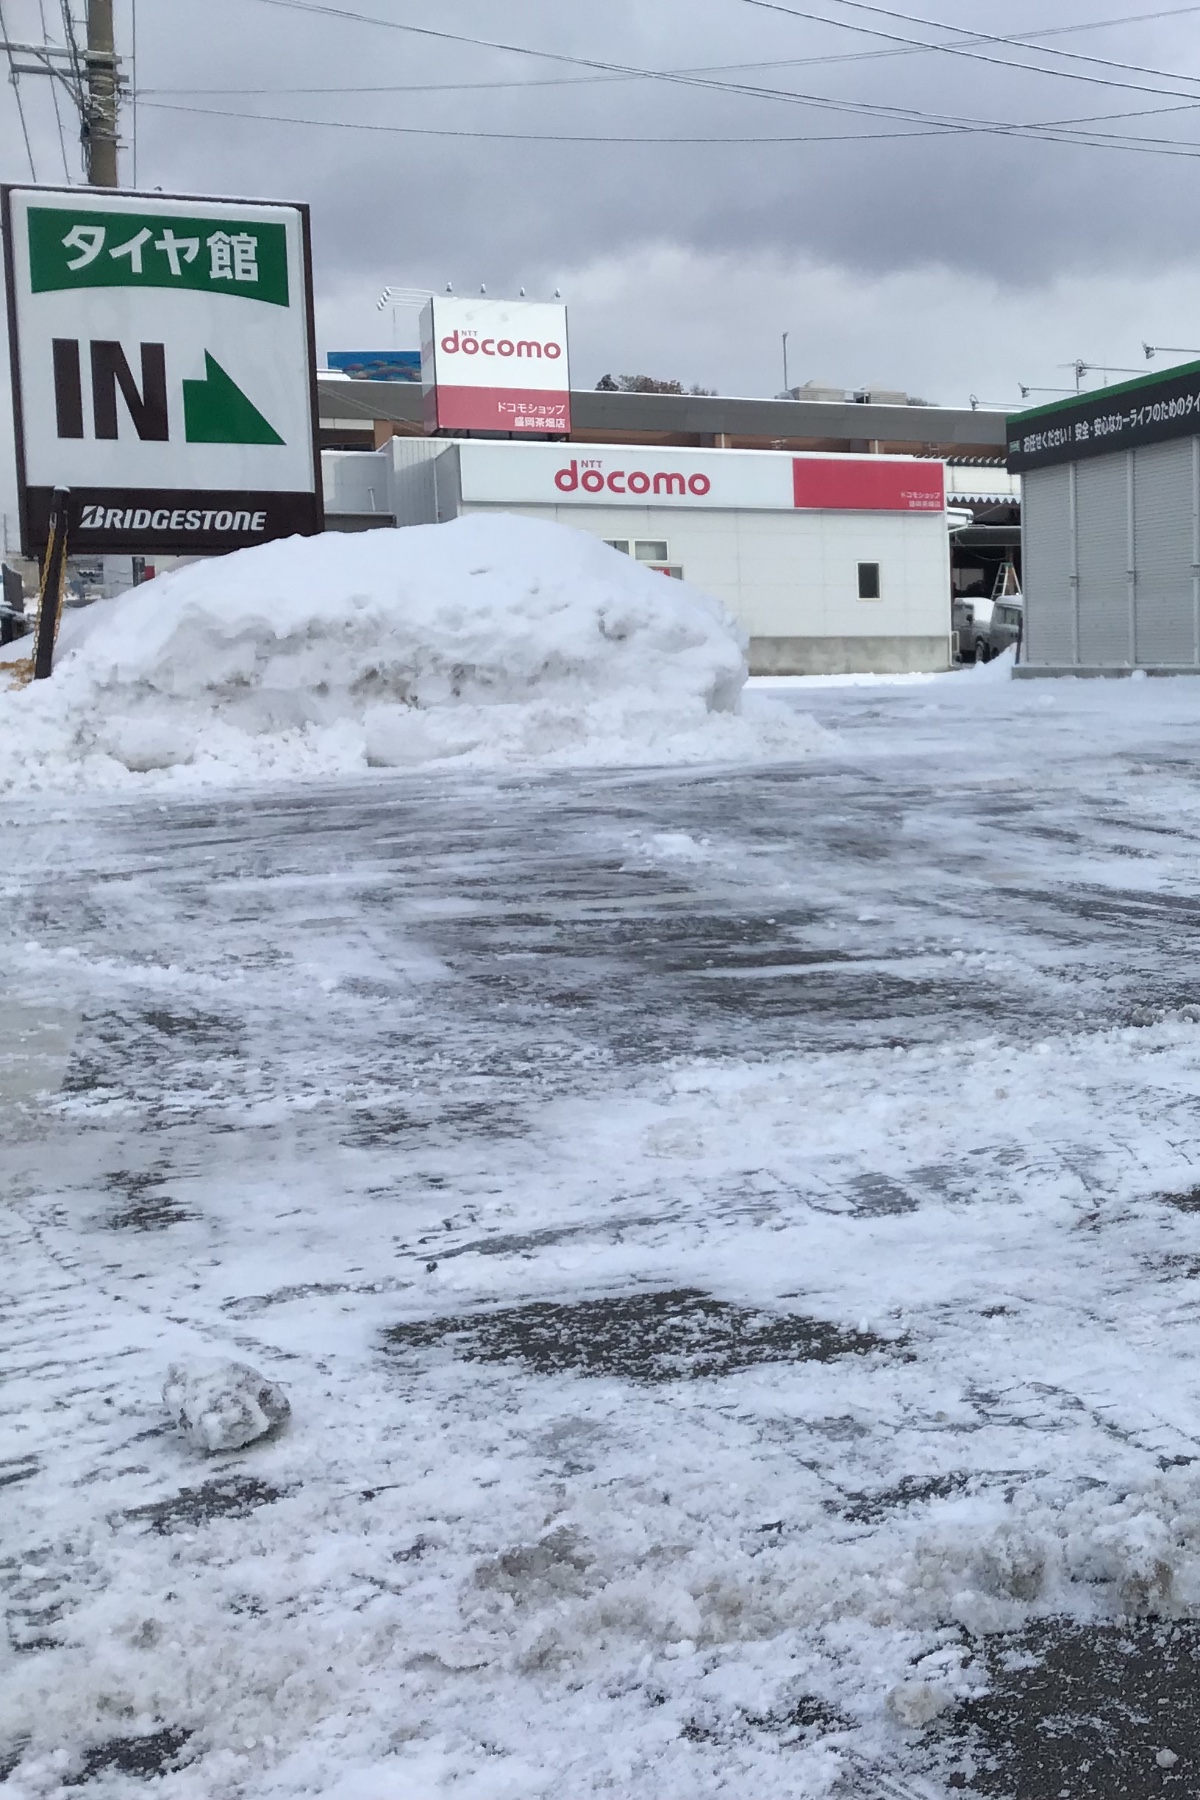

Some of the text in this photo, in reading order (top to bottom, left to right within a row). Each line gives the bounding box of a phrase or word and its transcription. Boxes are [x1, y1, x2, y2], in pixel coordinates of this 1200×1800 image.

[61, 224, 259, 282] タイヤ館
[441, 330, 562, 360] docomo
[52, 338, 169, 442] IN
[498, 402, 565, 415] ドコモショップ
[514, 416, 566, 429] 盛岡茶畑店
[554, 459, 711, 496] docomo
[581, 460, 603, 468] NTT
[79, 505, 268, 532] BRIDGESTONE
